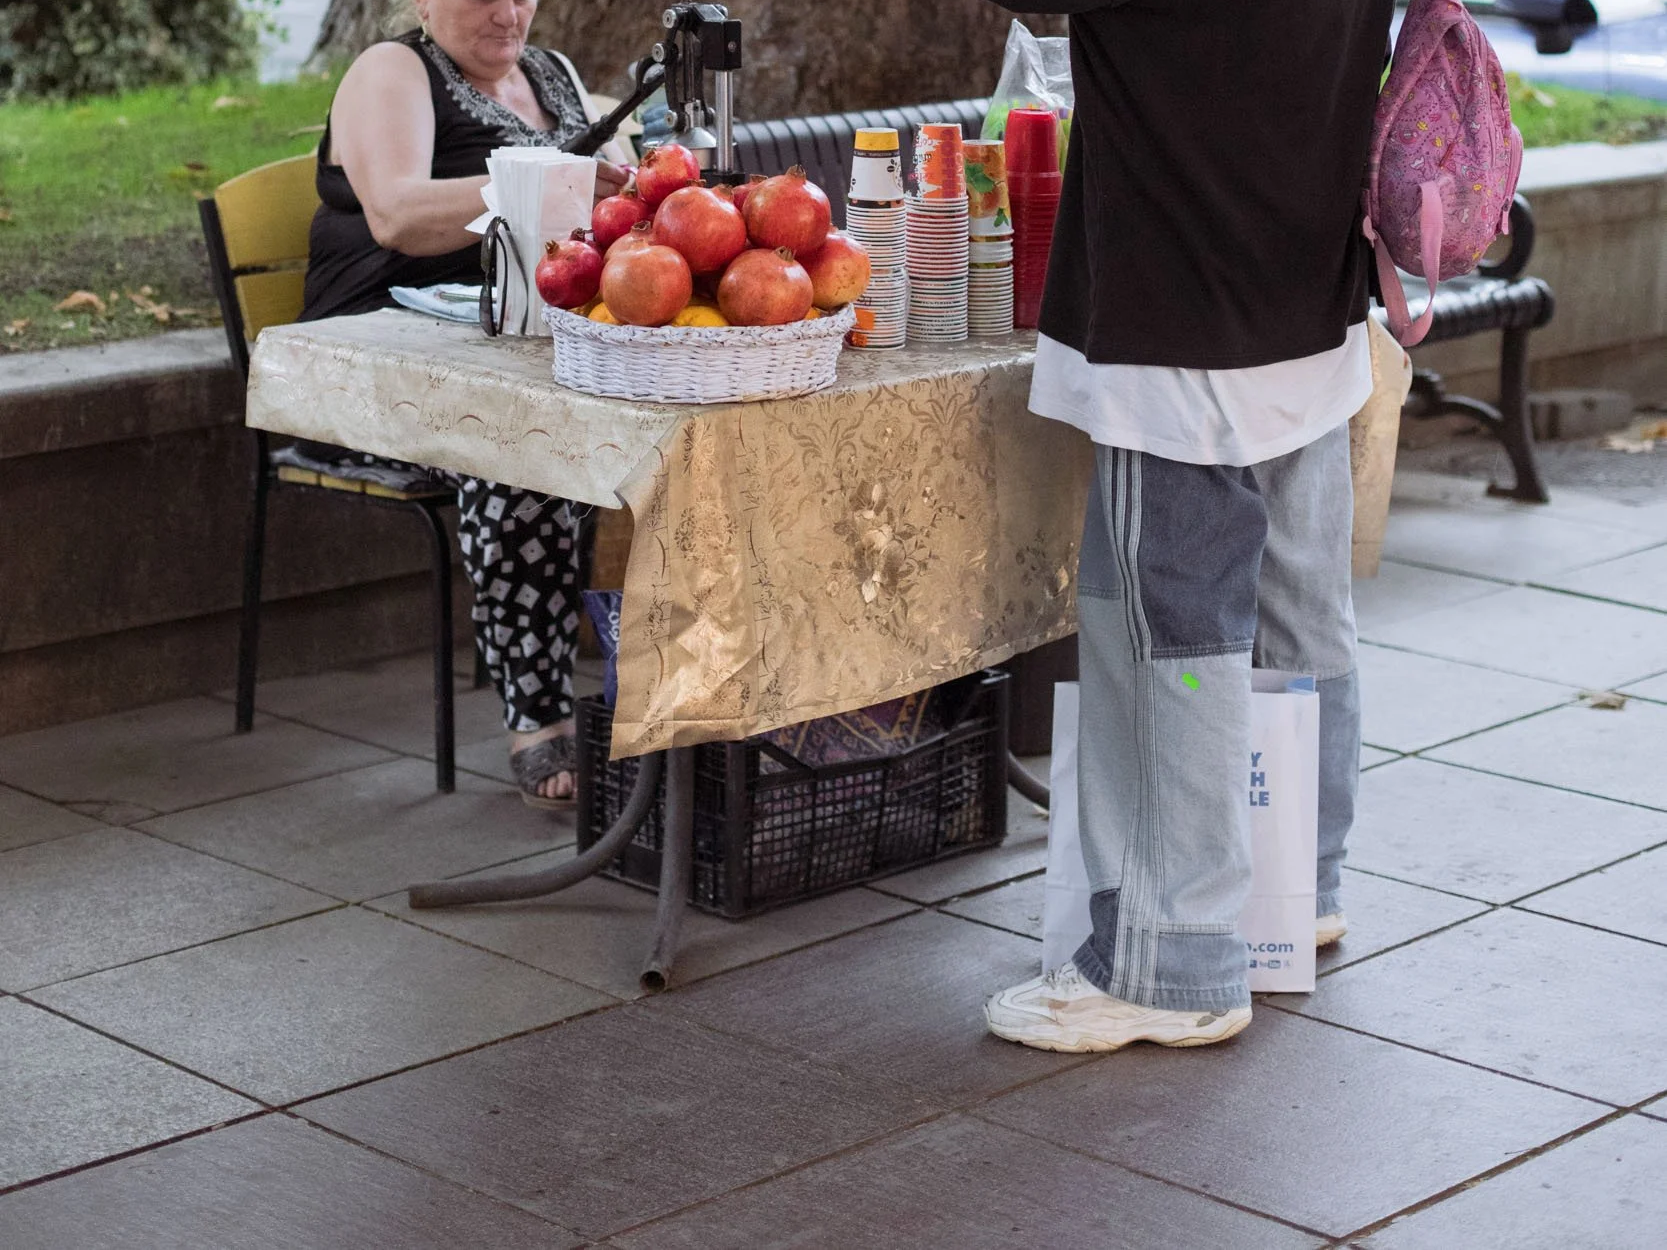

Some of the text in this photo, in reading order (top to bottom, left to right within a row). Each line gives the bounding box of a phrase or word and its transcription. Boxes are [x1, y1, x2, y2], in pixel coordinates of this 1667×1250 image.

[1250, 751, 1263, 768] Y
[1250, 771, 1265, 787] H
[1249, 791, 1269, 806] LE
[1246, 942, 1294, 953] .com
